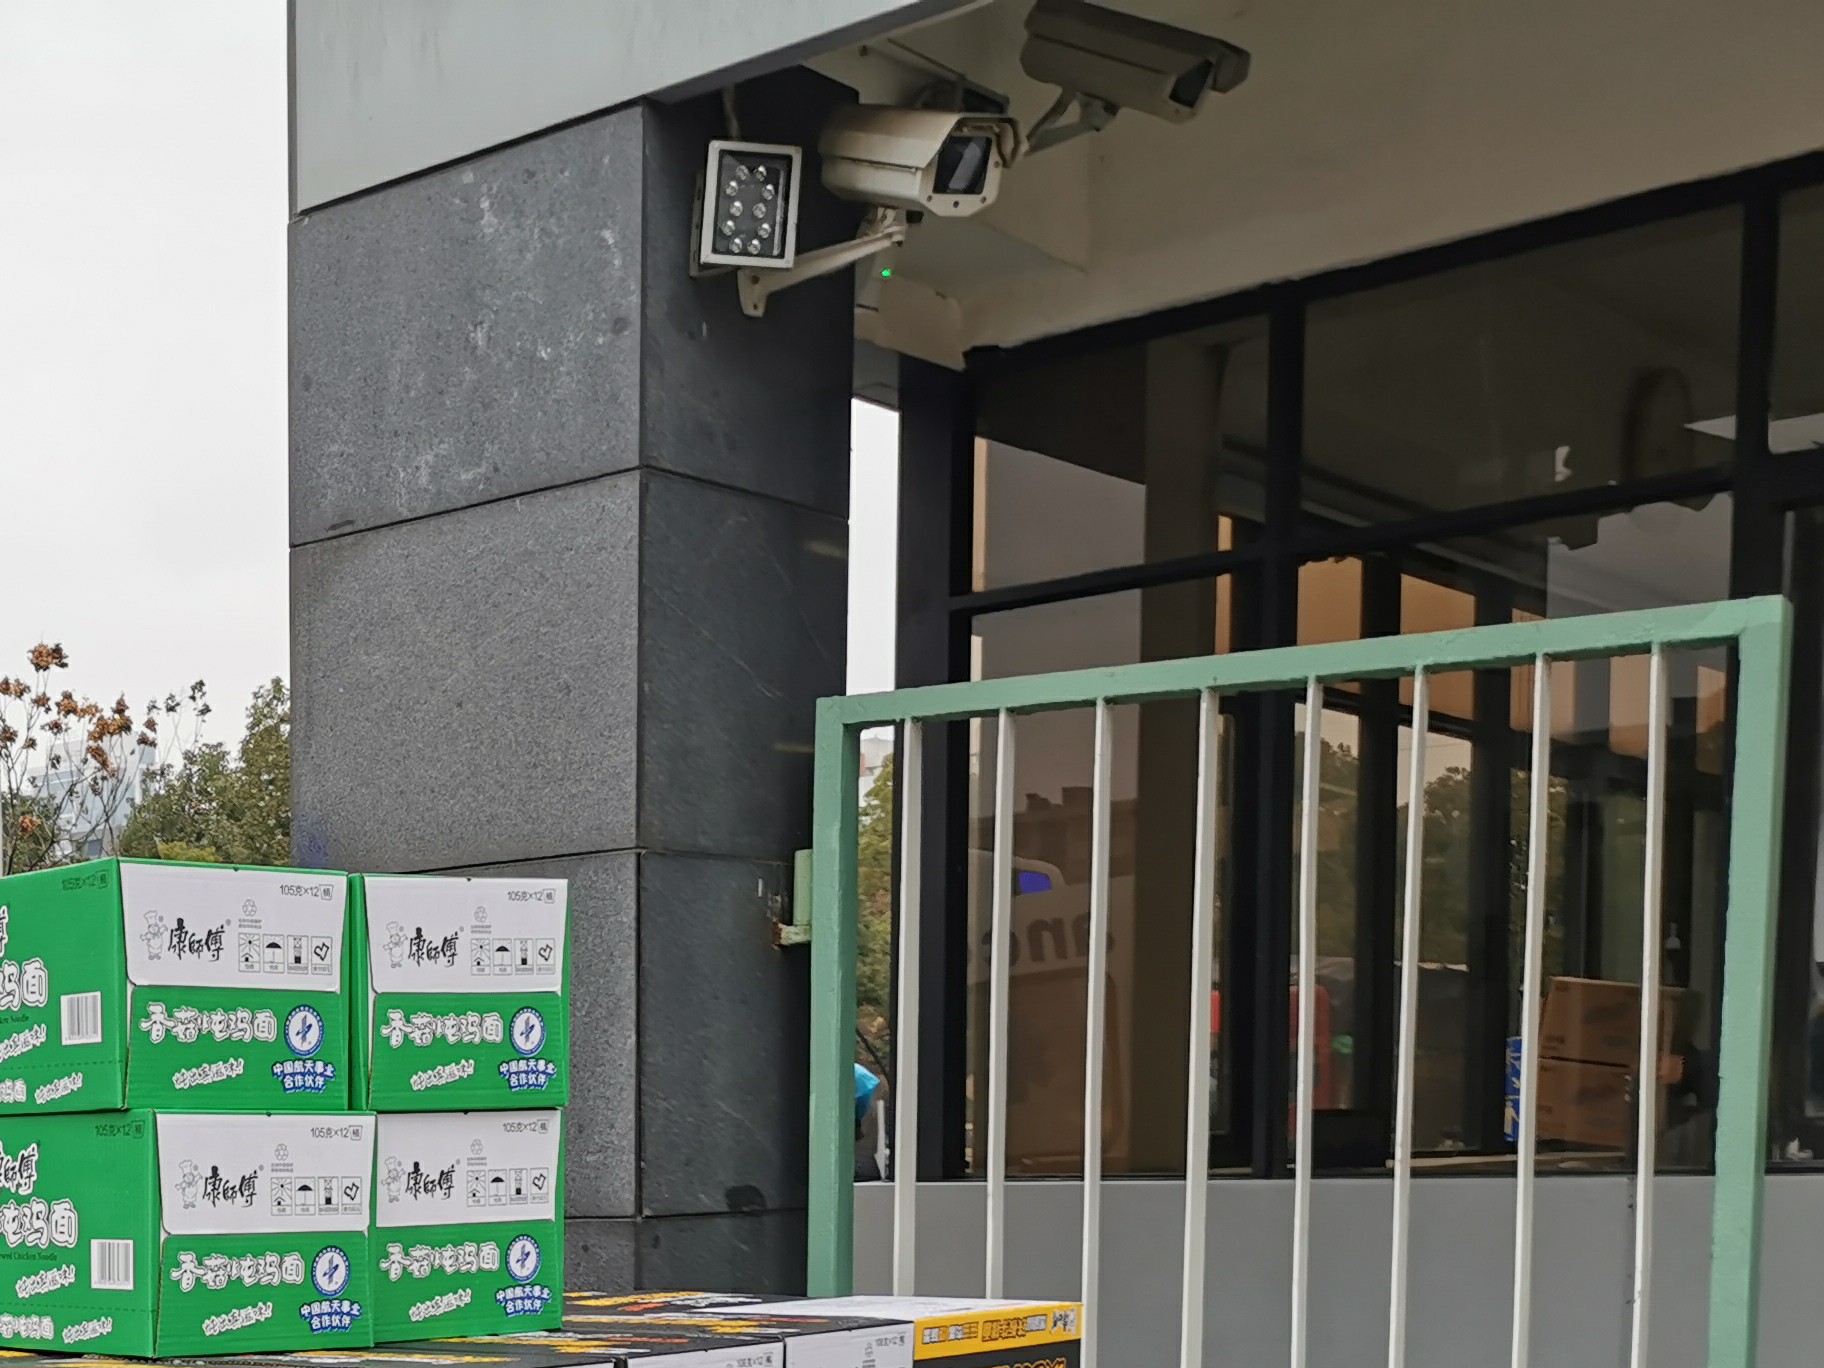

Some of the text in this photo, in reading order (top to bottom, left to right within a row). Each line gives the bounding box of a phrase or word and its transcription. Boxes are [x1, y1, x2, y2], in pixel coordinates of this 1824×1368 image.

[168, 918, 225, 962] 康師傅
[409, 927, 459, 967] 康師傅
[139, 1002, 277, 1044] 香菇炖鸡面
[380, 1009, 503, 1048] 香菇炖鸡面
[272, 1059, 336, 1078] 中国航天事业
[283, 1074, 327, 1093] 合作伙伴
[499, 1058, 557, 1078] 中国航天事业
[203, 1166, 258, 1208] 康師傅
[406, 1162, 455, 1200] 康師傅
[170, 1251, 305, 1292] 香菇炖鸡面
[380, 1242, 500, 1281] 香菇炖鸡面
[300, 1299, 362, 1319] 中国航天事业
[495, 1284, 552, 1304] 中国航天事业
[309, 1314, 353, 1333] 合作伙伴
